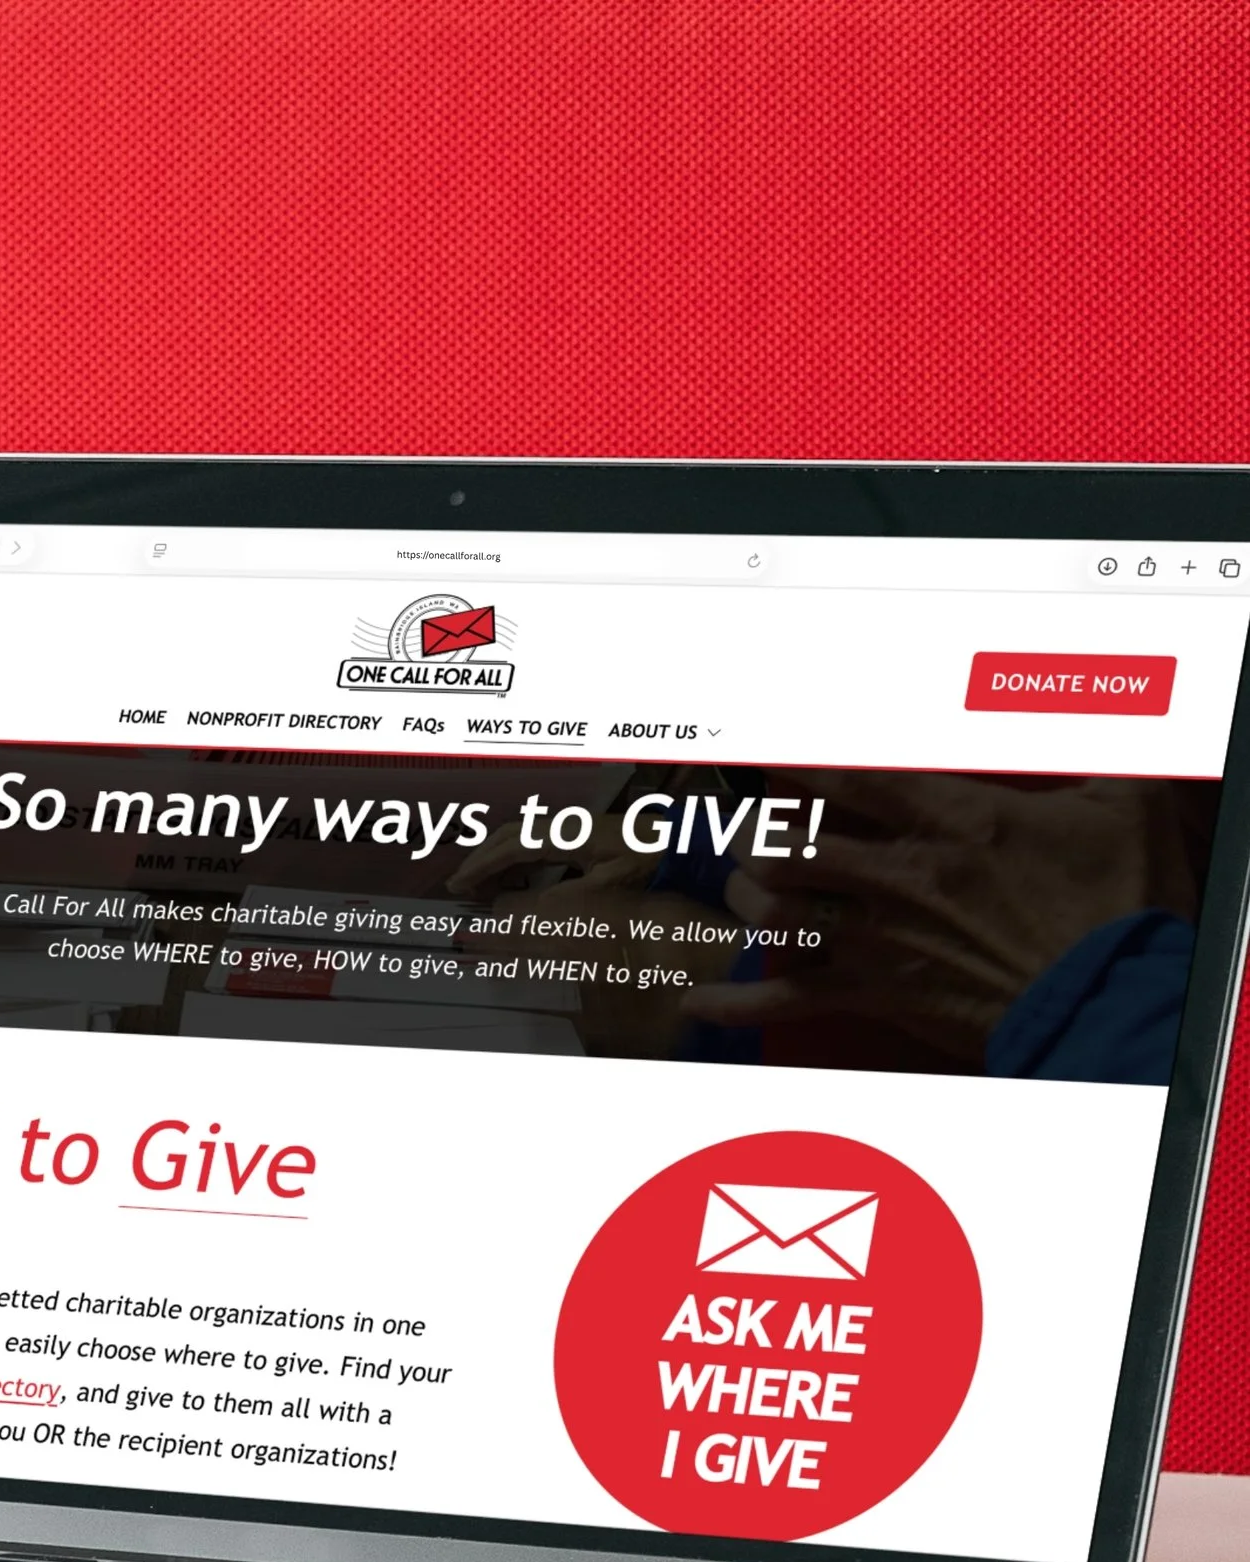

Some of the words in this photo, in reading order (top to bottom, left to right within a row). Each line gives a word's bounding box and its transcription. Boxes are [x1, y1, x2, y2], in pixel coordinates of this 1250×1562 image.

[396, 550, 501, 563] https://onecallforall.org
[346, 665, 387, 683] ONE
[390, 667, 430, 684] CALL
[434, 668, 472, 686] FOR
[474, 669, 503, 687] ALL
[991, 673, 1085, 693] DONATE
[1092, 675, 1150, 694] NOW
[118, 709, 168, 724] HOME
[186, 711, 286, 728] NONPROFIT
[288, 713, 383, 731] DIRECTORY
[402, 717, 445, 735] FAQs
[467, 718, 513, 735] WAYS
[518, 720, 542, 736] TO
[547, 721, 589, 737] GIVE
[607, 723, 671, 739] ABOUT
[675, 724, 698, 740] US
[90, 790, 289, 854] many
[313, 797, 490, 860] ways
[519, 794, 593, 851] to
[621, 793, 825, 859] GIVE!
[183, 855, 245, 874] TRAY
[3, 893, 45, 915] Call
[52, 895, 90, 916] For
[95, 897, 126, 918] All
[132, 899, 204, 921] makes
[211, 902, 328, 927] charitable
[333, 908, 403, 935] giving
[410, 915, 463, 937] easy
[469, 913, 514, 934] and
[521, 914, 616, 939] flexible.
[629, 919, 664, 941] We
[671, 921, 738, 944] allow
[743, 929, 788, 950] you
[797, 928, 821, 948] to
[48, 937, 125, 961] choose
[133, 941, 214, 965] WHERE
[220, 947, 243, 966] to
[249, 947, 303, 972] give,
[313, 949, 373, 971] HOW
[379, 953, 403, 973] to
[409, 954, 464, 980] give,
[474, 957, 519, 979] and
[527, 958, 598, 982] WHEN
[606, 964, 630, 983] to
[637, 964, 693, 989] give.
[20, 1118, 99, 1186] to
[132, 1119, 316, 1199] Give
[65, 1292, 183, 1320] charitable
[189, 1304, 345, 1331] organizations
[353, 1311, 374, 1333] in
[382, 1318, 426, 1337] one
[661, 1294, 778, 1348] ASK
[783, 1302, 874, 1355] ME
[5, 1334, 72, 1361] easily
[77, 1337, 156, 1362] choose
[164, 1343, 236, 1368] where
[244, 1350, 267, 1371] to
[273, 1352, 329, 1377] give.
[340, 1355, 392, 1380] Find
[397, 1365, 453, 1386] your
[76, 1383, 120, 1404] and
[125, 1386, 174, 1411] give
[182, 1391, 205, 1411] to
[214, 1391, 273, 1416] them
[281, 1397, 311, 1419] all
[319, 1401, 370, 1424] with
[378, 1409, 392, 1425] a
[658, 1360, 860, 1423] WHERE
[33, 1422, 66, 1445] OR
[73, 1426, 111, 1449] the
[118, 1432, 223, 1459] recipient
[231, 1443, 397, 1471] organizations!
[660, 1429, 681, 1479] I
[694, 1433, 828, 1490] GIVE
